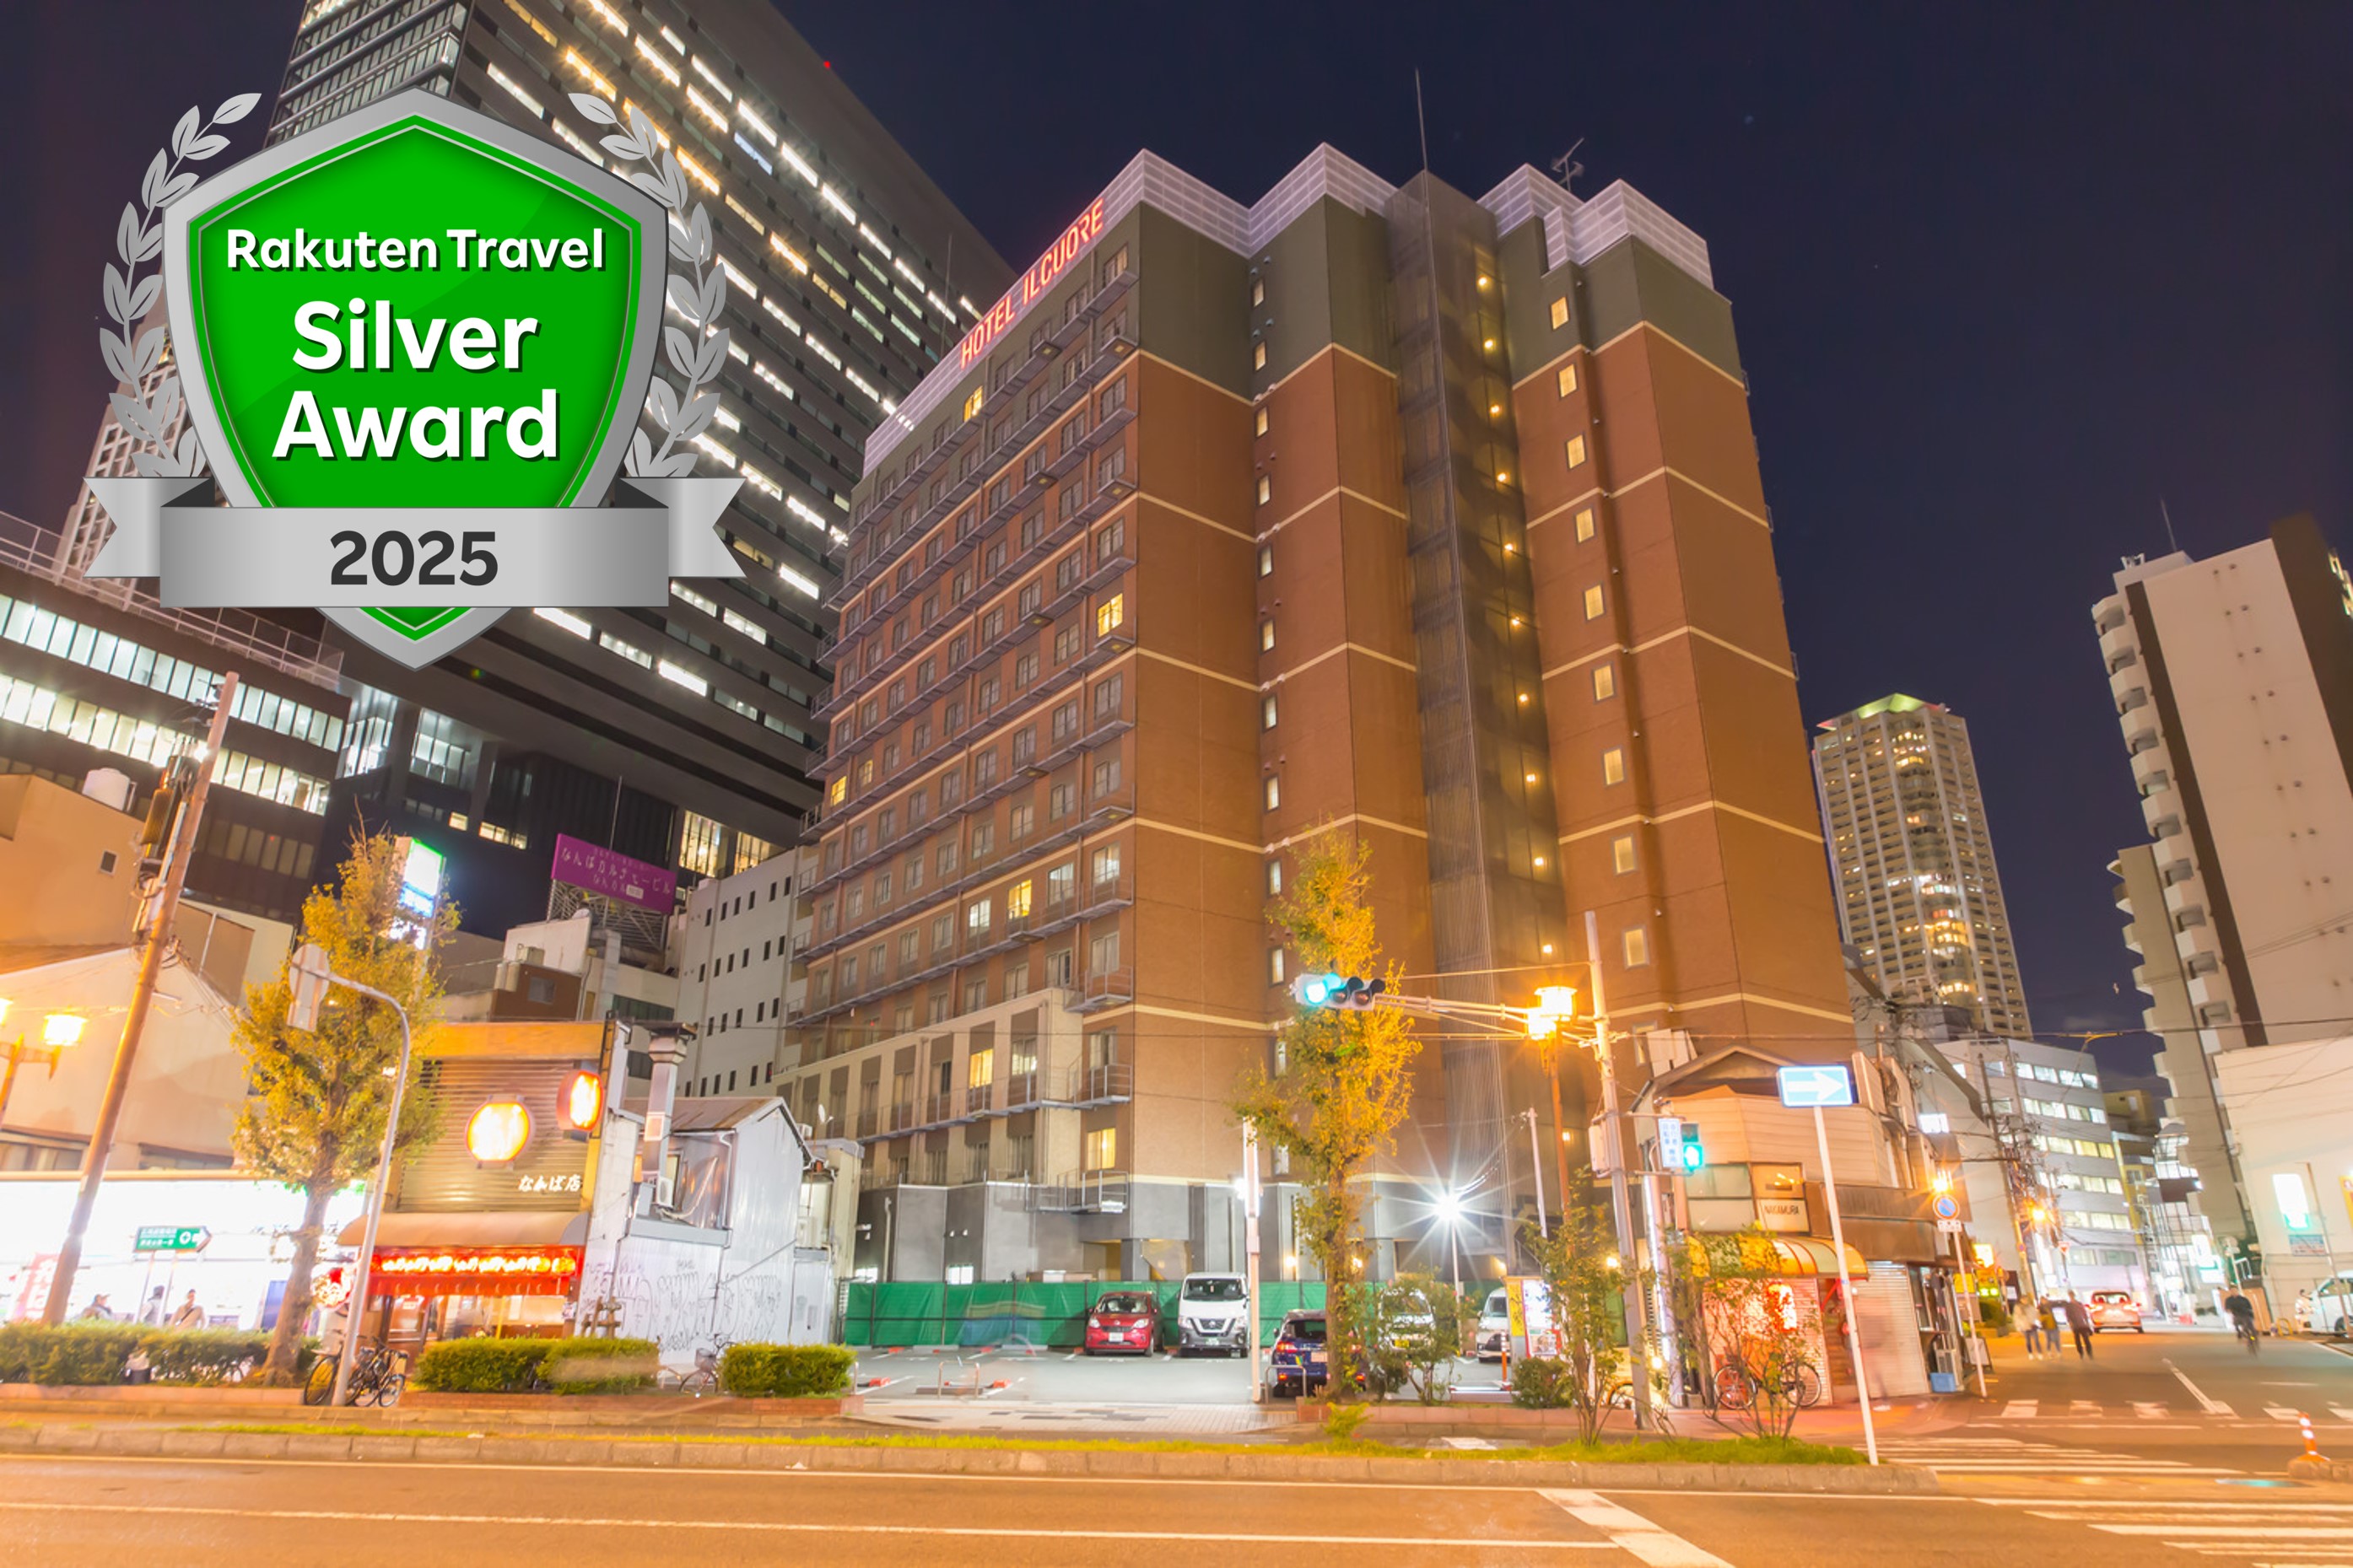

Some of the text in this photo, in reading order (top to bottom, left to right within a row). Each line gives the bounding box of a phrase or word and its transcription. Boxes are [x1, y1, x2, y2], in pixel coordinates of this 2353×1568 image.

[960, 294, 1016, 369] HOTEL
[518, 1173, 582, 1193] なんば店
